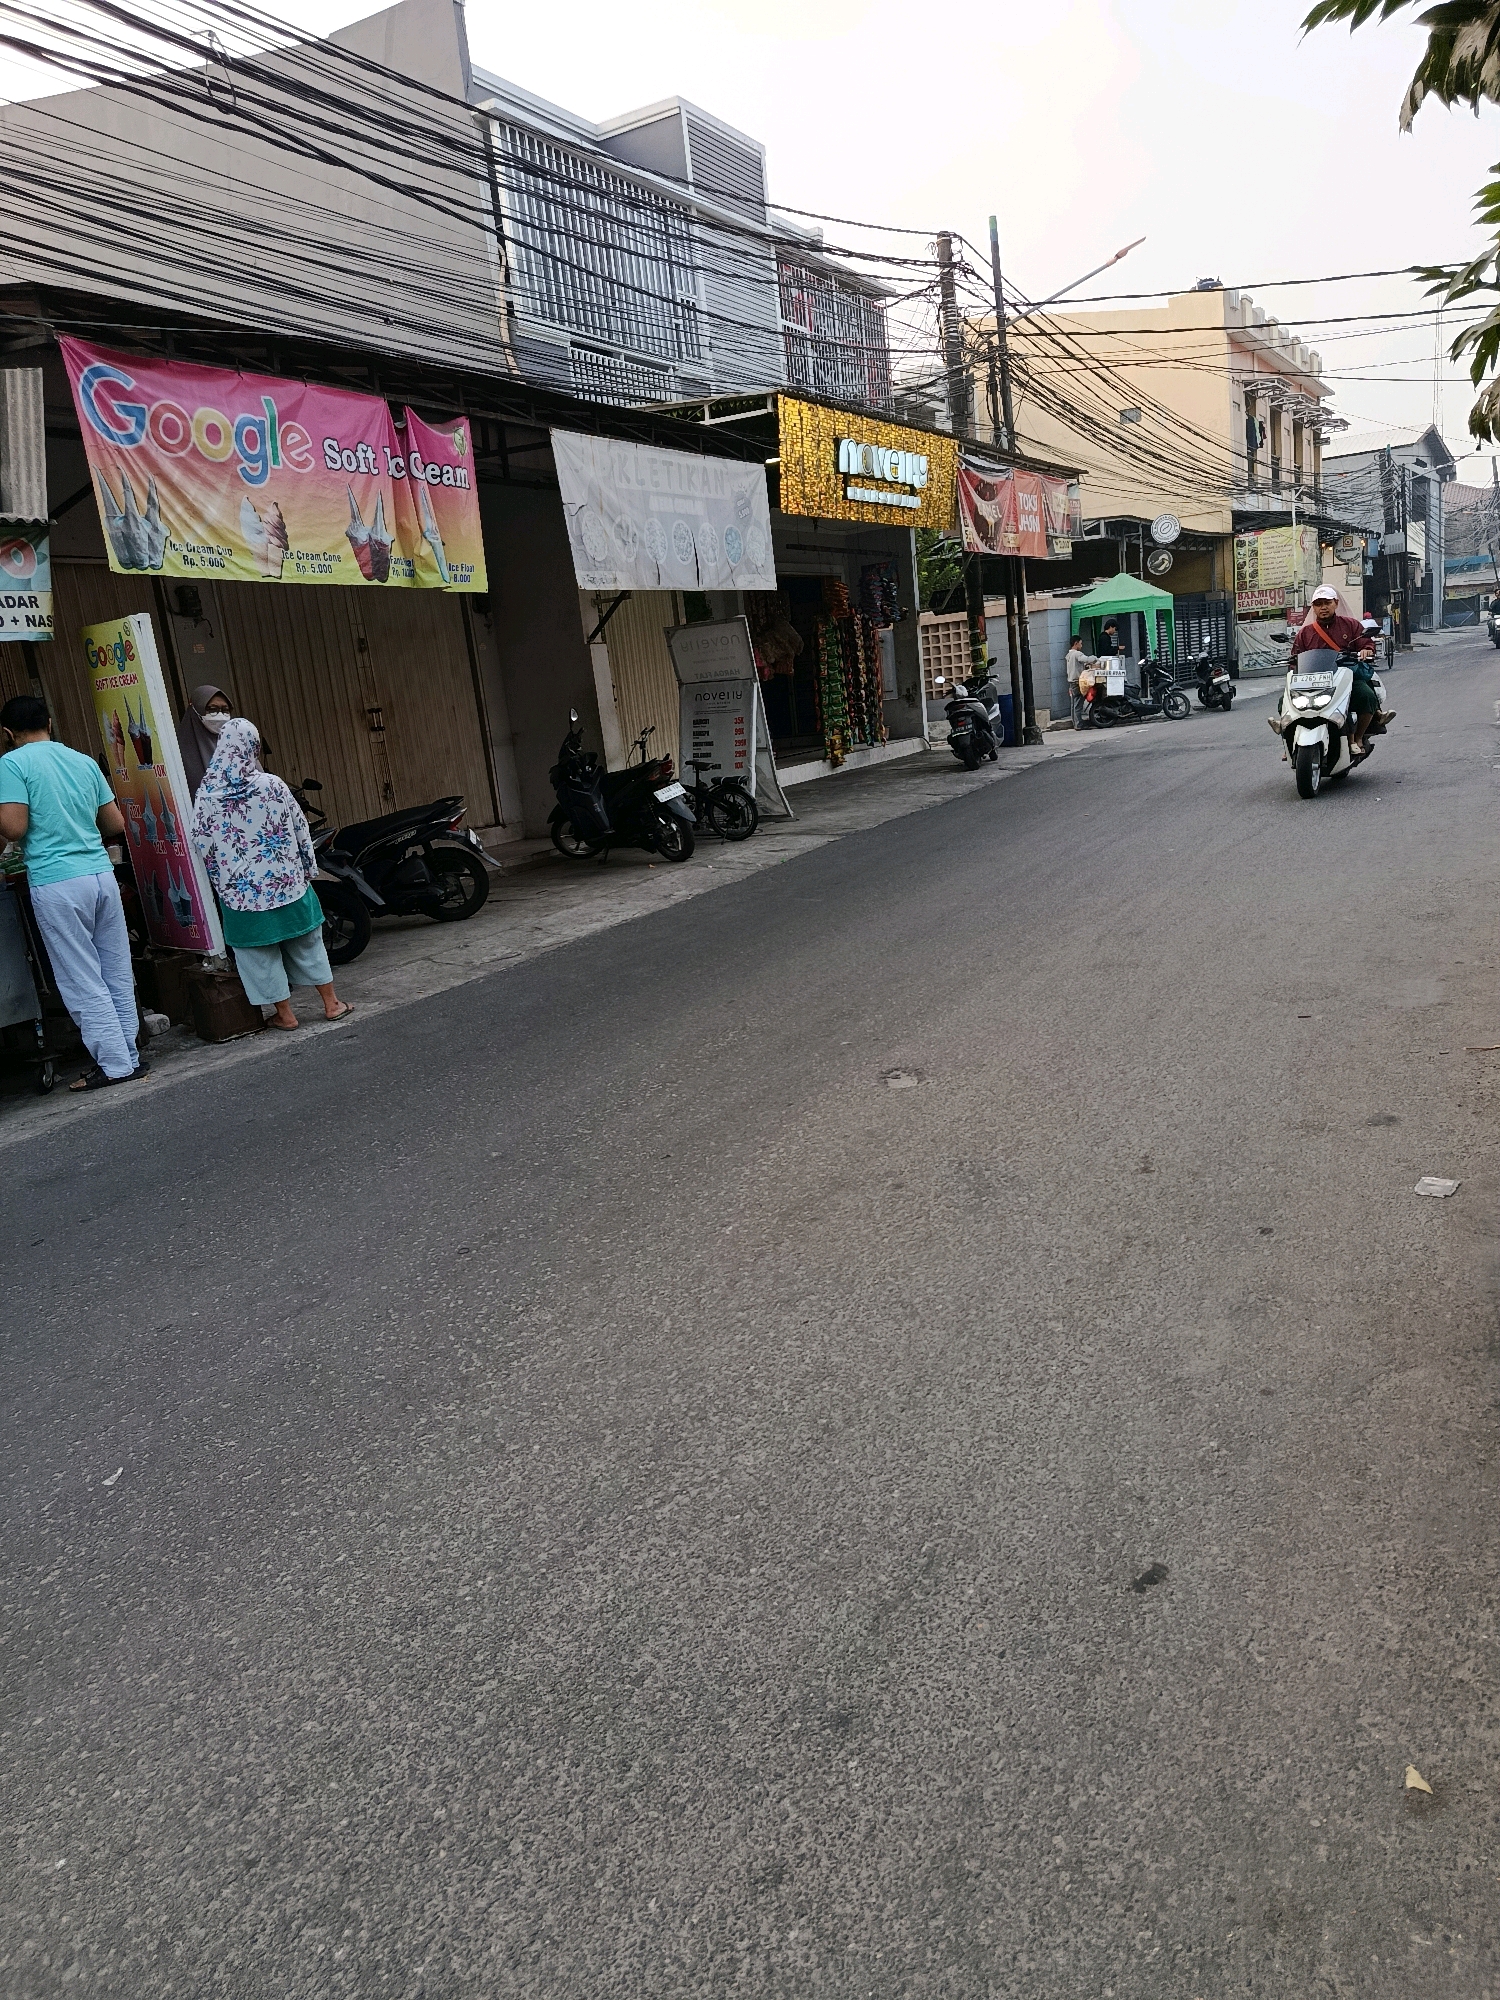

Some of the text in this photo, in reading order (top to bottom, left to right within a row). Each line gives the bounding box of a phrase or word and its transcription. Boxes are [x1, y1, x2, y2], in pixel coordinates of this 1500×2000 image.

[78, 363, 315, 488] Google
[322, 437, 471, 490] Soft Ic Ceam
[838, 438, 928, 489] novelly
[616, 452, 730, 496] KLETIKAN
[169, 540, 233, 558] Ice Cream Cup
[296, 550, 322, 562] Cream
[322, 552, 342, 562] Cone
[182, 555, 226, 568] Rp. 5.000
[295, 562, 333, 575] Rp. 5.000
[1237, 589, 1268, 601] BAKMI
[1237, 598, 1269, 609] SEAFOOD
[85, 632, 136, 672] Google
[95, 678, 109, 691] SOFT
[118, 672, 139, 687] CREAM
[695, 690, 743, 702] novelly
